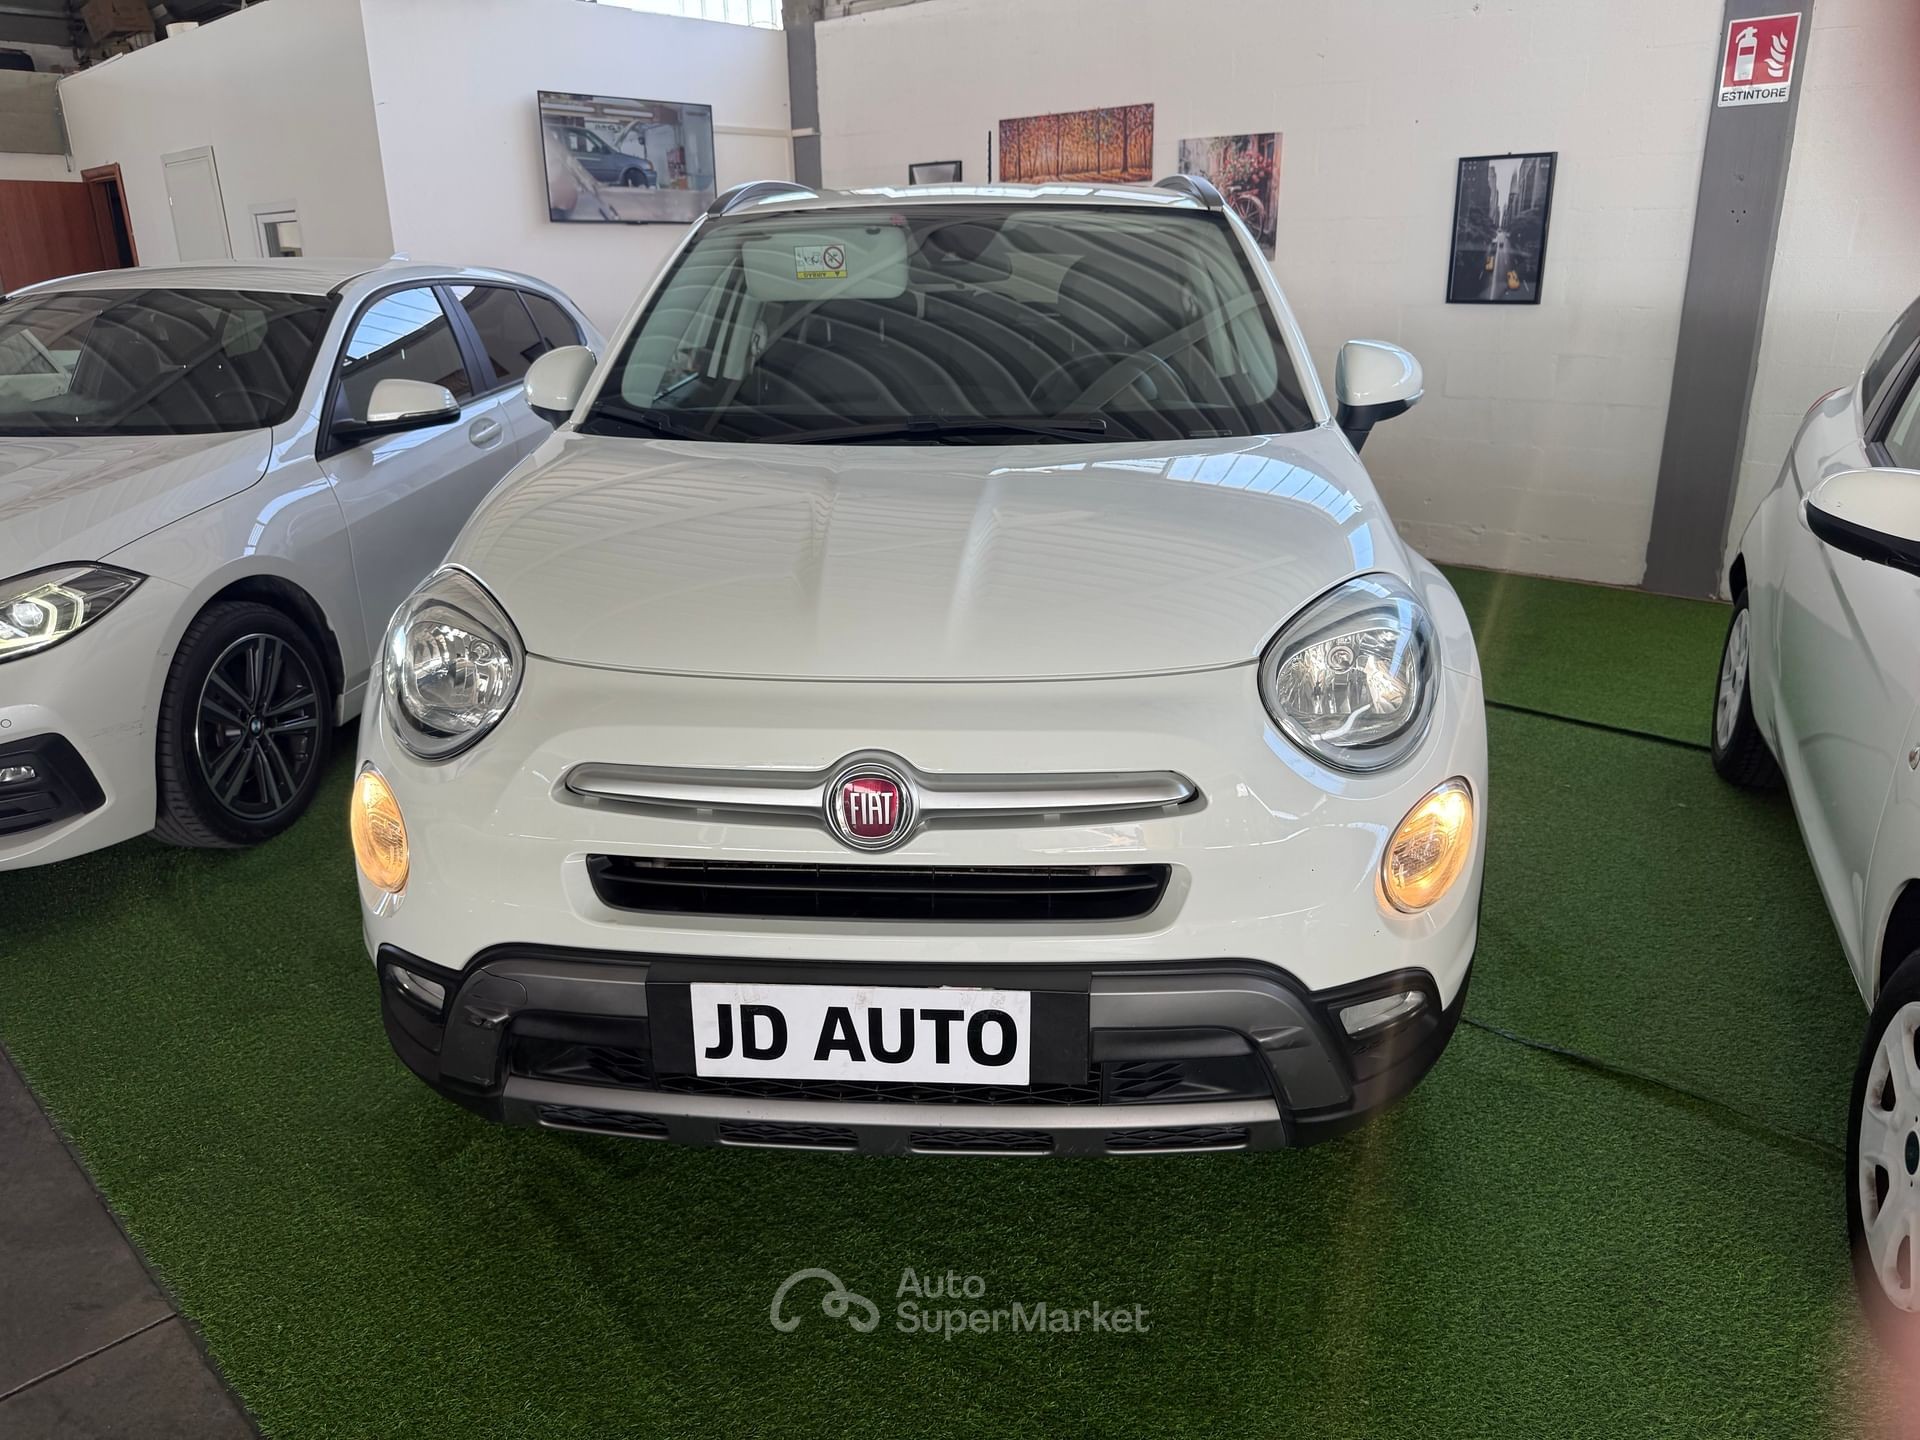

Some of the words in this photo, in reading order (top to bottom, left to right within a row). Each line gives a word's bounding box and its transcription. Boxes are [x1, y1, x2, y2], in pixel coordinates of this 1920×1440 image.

[1721, 88, 1787, 101] ESTINTORE
[850, 792, 893, 825] FIAT
[705, 1003, 788, 1061] JD
[813, 1006, 1017, 1067] AUTO
